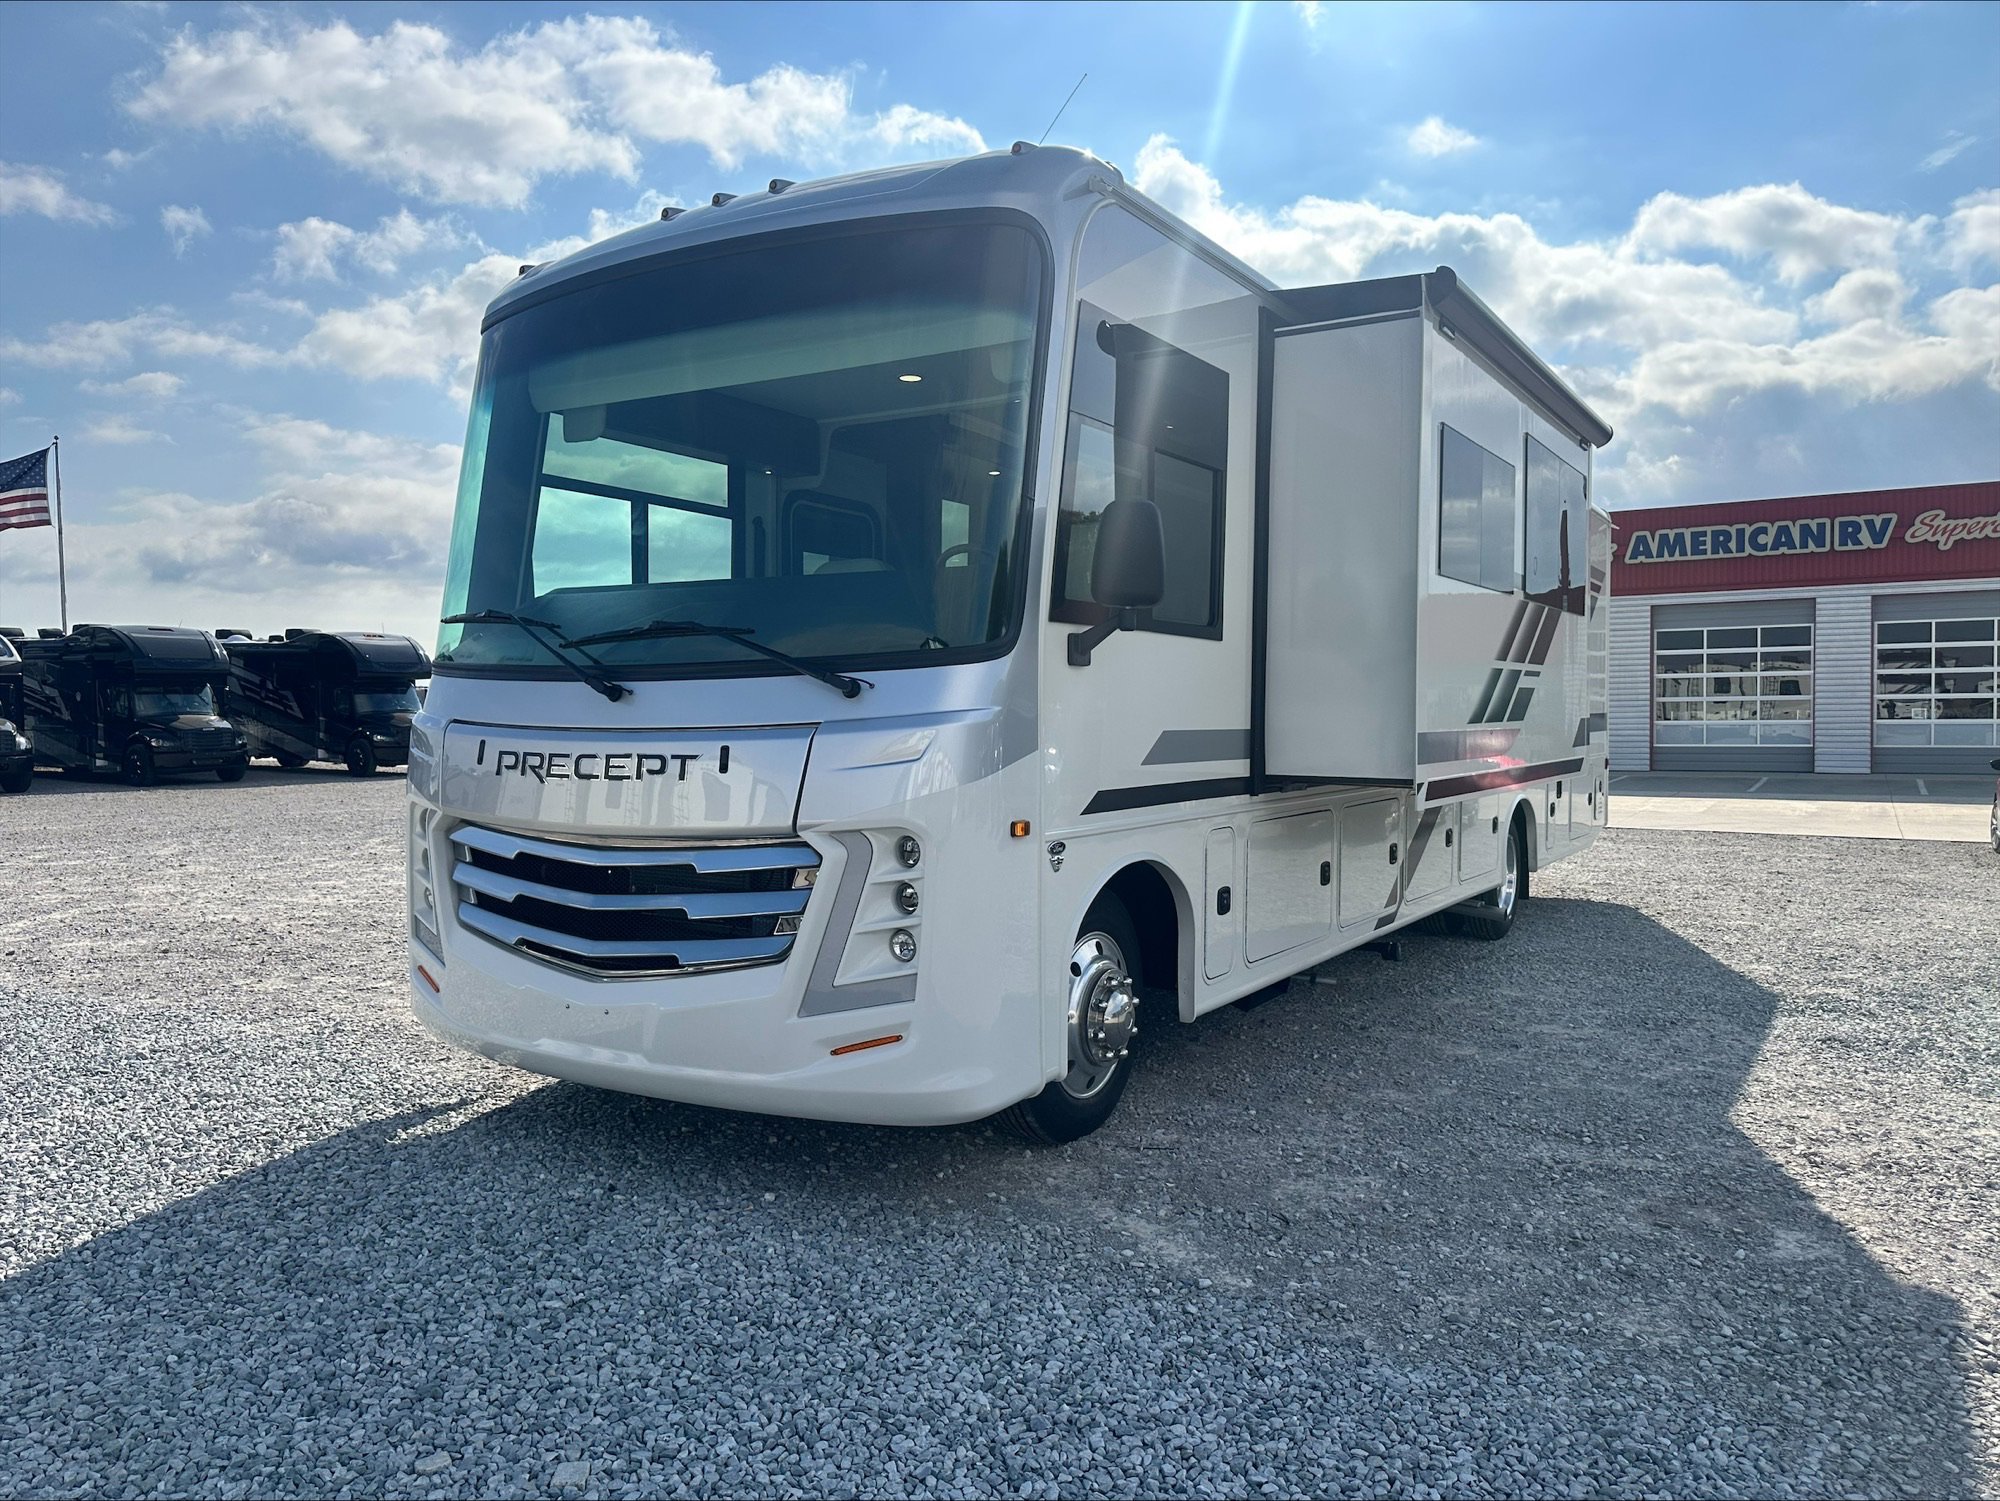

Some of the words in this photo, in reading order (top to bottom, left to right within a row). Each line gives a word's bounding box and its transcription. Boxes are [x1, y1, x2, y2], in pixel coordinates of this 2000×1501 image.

[1626, 518, 1829, 561] AMERICAN
[1836, 515, 1895, 549] RV
[496, 750, 703, 784] PRECEPT
